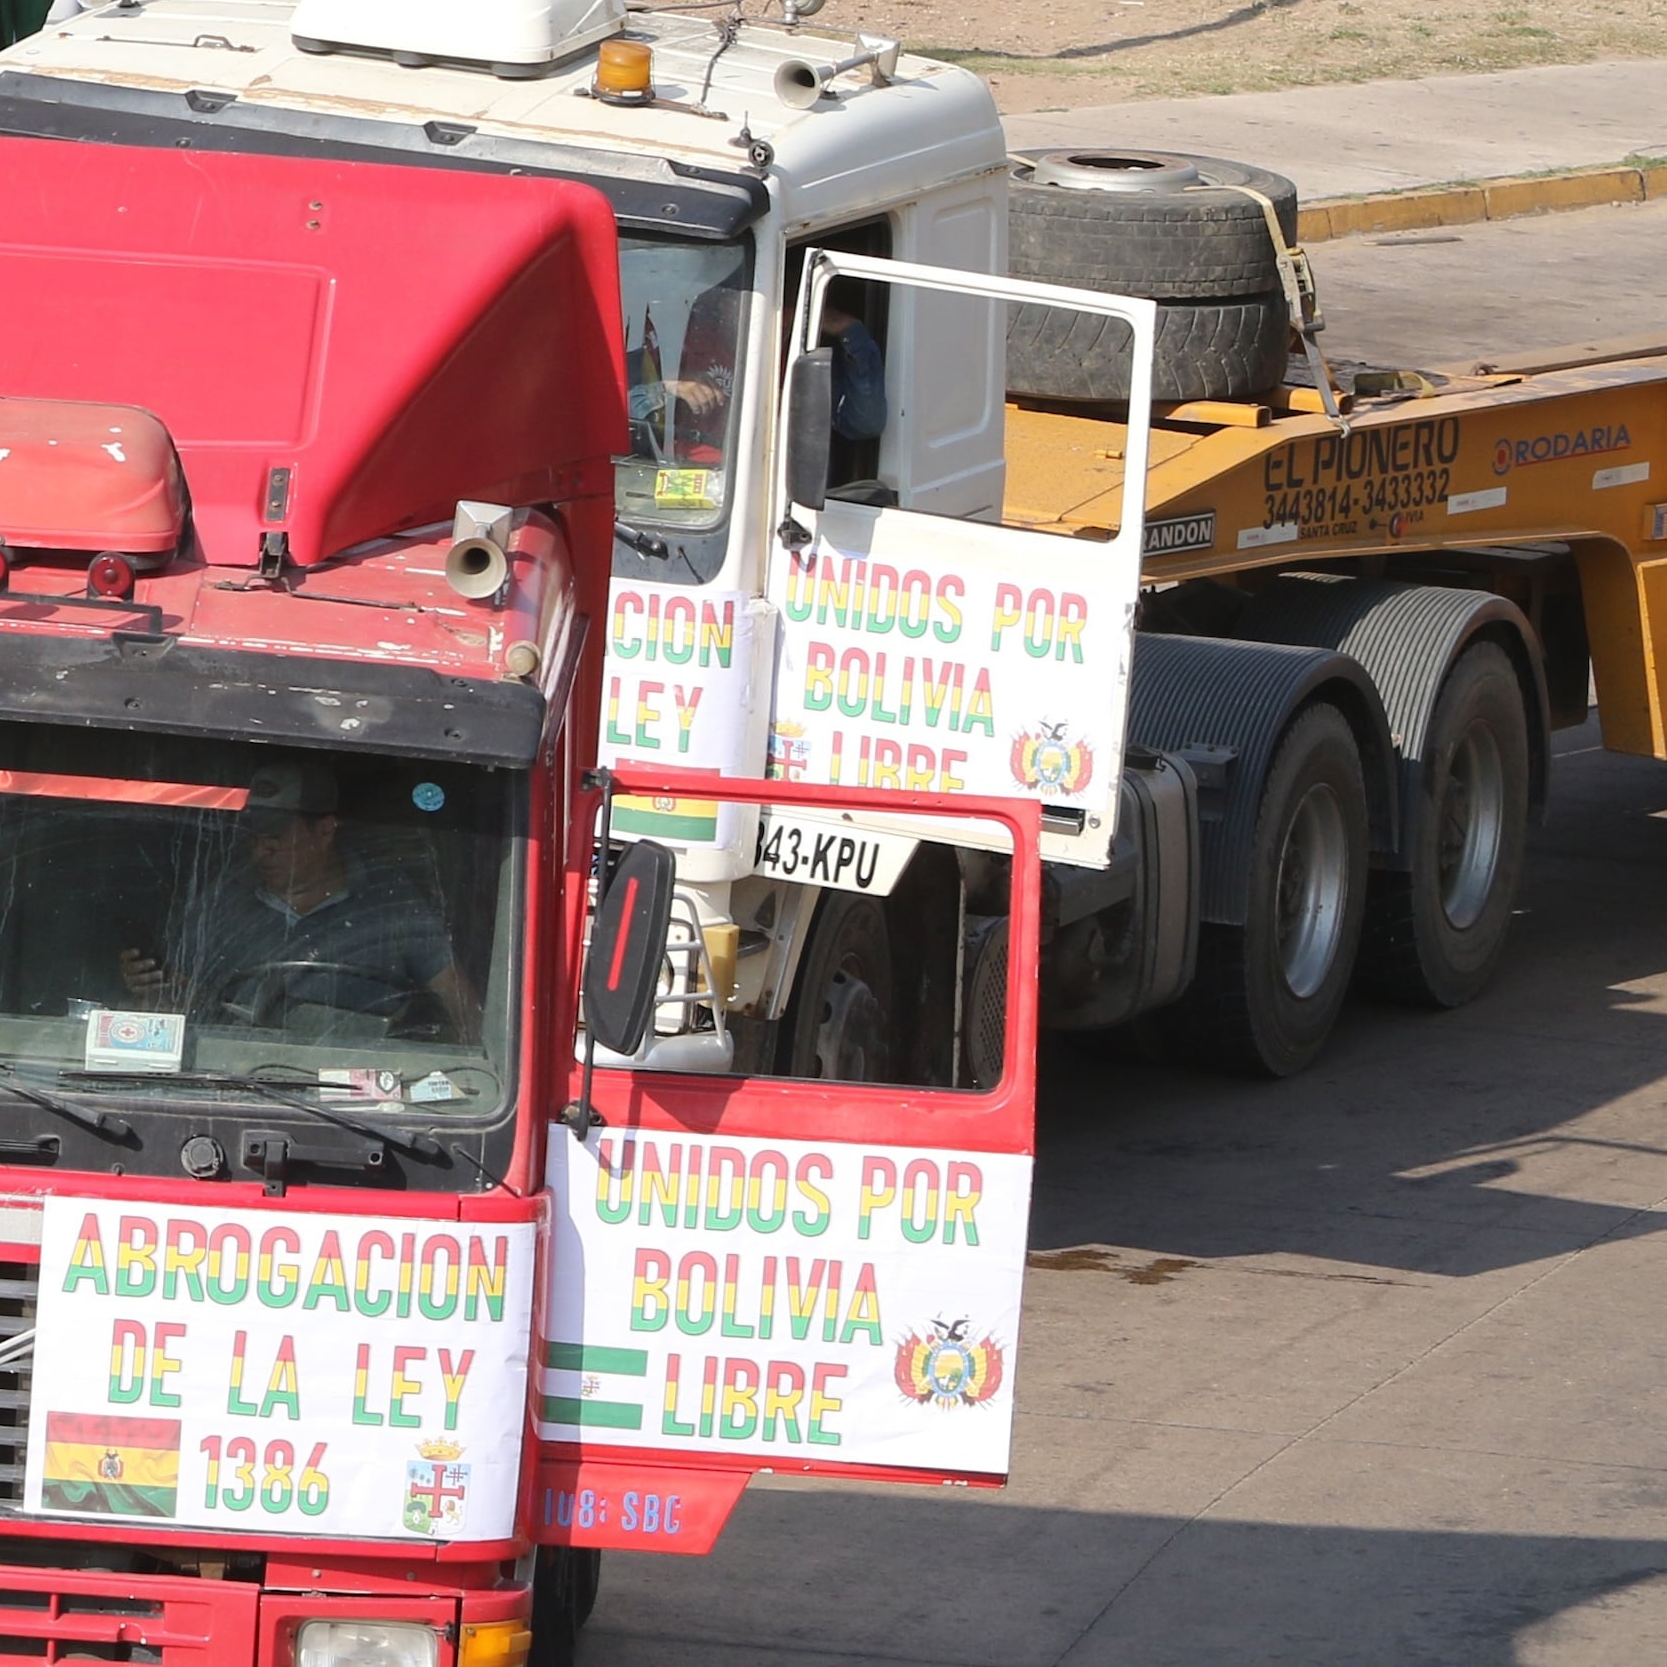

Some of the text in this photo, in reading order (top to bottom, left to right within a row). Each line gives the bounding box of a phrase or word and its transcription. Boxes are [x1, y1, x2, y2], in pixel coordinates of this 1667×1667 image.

[1264, 414, 1460, 493] EL PIONERO
[1515, 423, 1632, 465] RODARIA
[1263, 468, 1450, 531] 3443814-3433332
[1299, 524, 1330, 540] SANTA
[1331, 521, 1358, 537] CRUZ
[605, 589, 734, 669] CION
[785, 552, 1089, 665] UNIDOS POR
[606, 675, 705, 754] LEY
[803, 640, 996, 738] BOLIVIA
[828, 730, 969, 794] LIBRE
[595, 1138, 983, 1247] UNIDOS POR
[62, 1212, 508, 1323] ABROGACION
[629, 1246, 883, 1346] BOLIVIA
[107, 1318, 476, 1431] DE LA LEY
[660, 1353, 850, 1446] LIBRE
[198, 1434, 329, 1516] 1386
